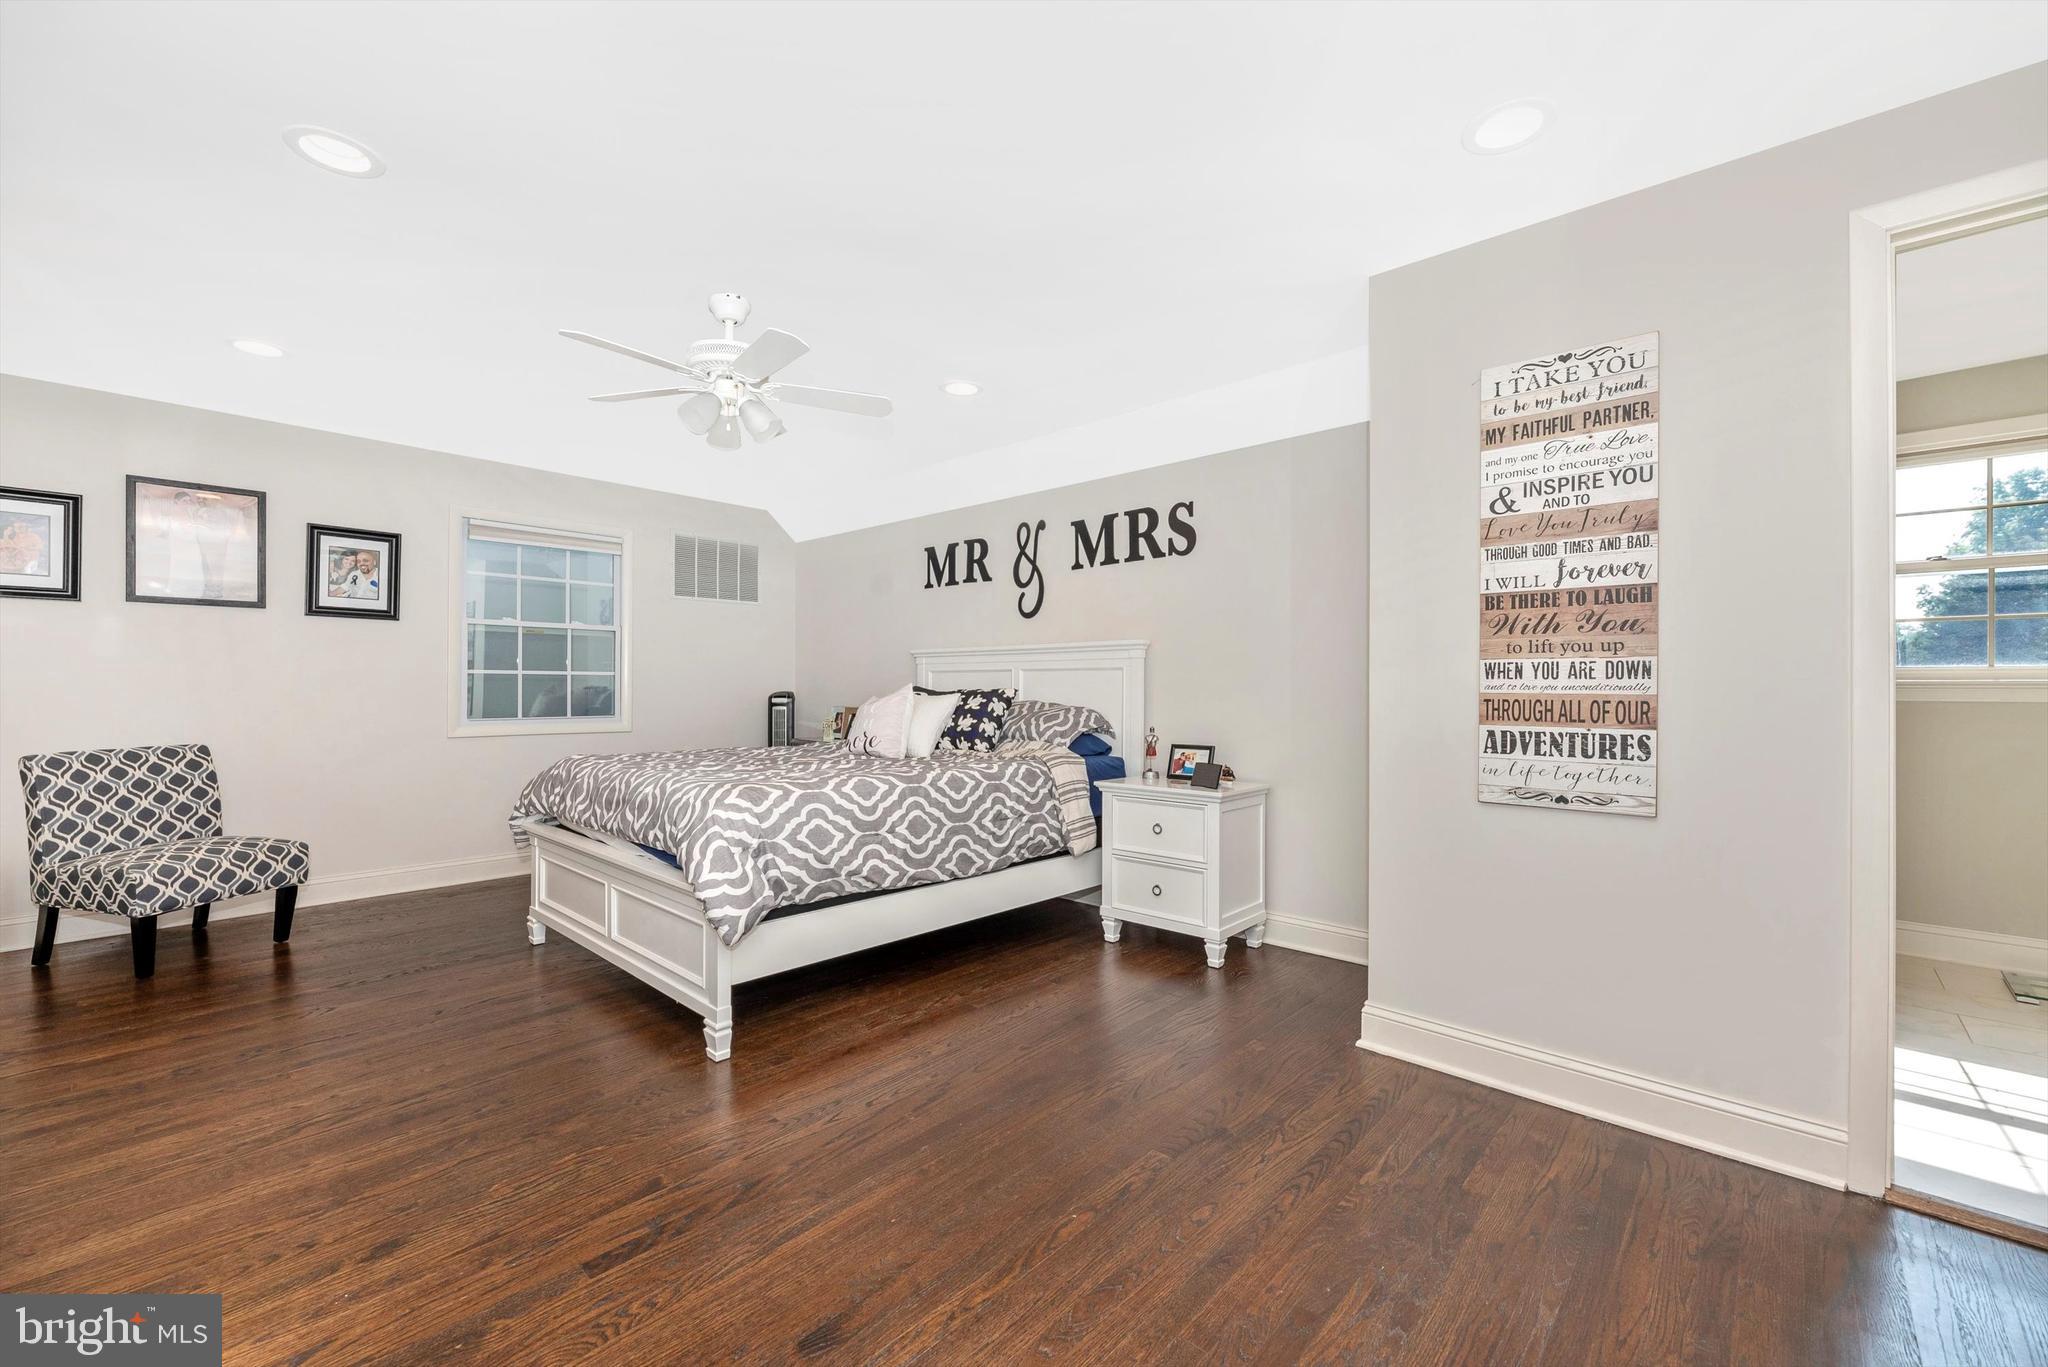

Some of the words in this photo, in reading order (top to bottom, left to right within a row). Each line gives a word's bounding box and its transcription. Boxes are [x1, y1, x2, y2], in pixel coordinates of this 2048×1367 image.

[1494, 381, 1502, 398] I
[1508, 365, 1580, 394] TAKE
[1587, 350, 1648, 377] YOU
[1493, 404, 1508, 417] to
[1513, 400, 1530, 413] be
[1535, 395, 1557, 410] my
[1560, 386, 1591, 404] best
[1485, 426, 1507, 446] MY
[1512, 414, 1575, 441] FAITHFUL
[1583, 401, 1654, 429] PARTNER,
[1485, 457, 1502, 468] and
[1504, 457, 1518, 466] my
[1520, 453, 1539, 461] one
[1543, 439, 1596, 460] True
[1485, 473, 1489, 482] I
[1493, 468, 1538, 484] promise
[1542, 464, 1555, 474] to
[1559, 455, 1625, 471] encourage
[1628, 450, 1653, 464] you
[1489, 486, 1521, 515] &
[1523, 471, 1605, 498] INSPIRE
[1609, 464, 1654, 487] YOU
[1542, 496, 1570, 510] AND
[1573, 493, 1591, 506] TO
[1484, 517, 1531, 541] Love
[1537, 512, 1577, 538] You
[924, 538, 993, 589] MR
[1013, 519, 1046, 619] &
[1070, 501, 1198, 571] MRS
[1485, 545, 1528, 562] THROUGH
[1532, 542, 1557, 557] GOOD
[1563, 539, 1594, 555] TIMES
[1600, 536, 1622, 551] AND
[1627, 533, 1654, 549] BAD.
[1485, 579, 1489, 590] I
[1496, 575, 1546, 590] WILL
[1553, 558, 1653, 588] forever
[1485, 595, 1504, 611] BE
[1510, 592, 1561, 609] THERE
[1566, 590, 1587, 606] TO
[1594, 586, 1653, 605] LAUGH
[1488, 612, 1568, 636] With
[1506, 643, 1522, 654] to
[1528, 639, 1556, 654] lift
[1560, 642, 1593, 656] you
[1601, 641, 1625, 655] up
[1484, 662, 1523, 680] WHEN
[1531, 661, 1559, 679] YOU
[1568, 661, 1596, 679] ARE
[1605, 660, 1652, 679] DOWN
[1484, 683, 1504, 691] and
[1521, 682, 1538, 690] love
[1540, 684, 1558, 693] you
[1561, 683, 1652, 694] unconditionally
[1483, 699, 1554, 722] THROUGH
[1557, 700, 1586, 723] ALL
[1590, 700, 1611, 724] OF
[1615, 700, 1651, 724] OUR
[1483, 729, 1652, 762] ADVENTURES
[1482, 764, 1504, 776] in
[1508, 761, 1551, 786] life
